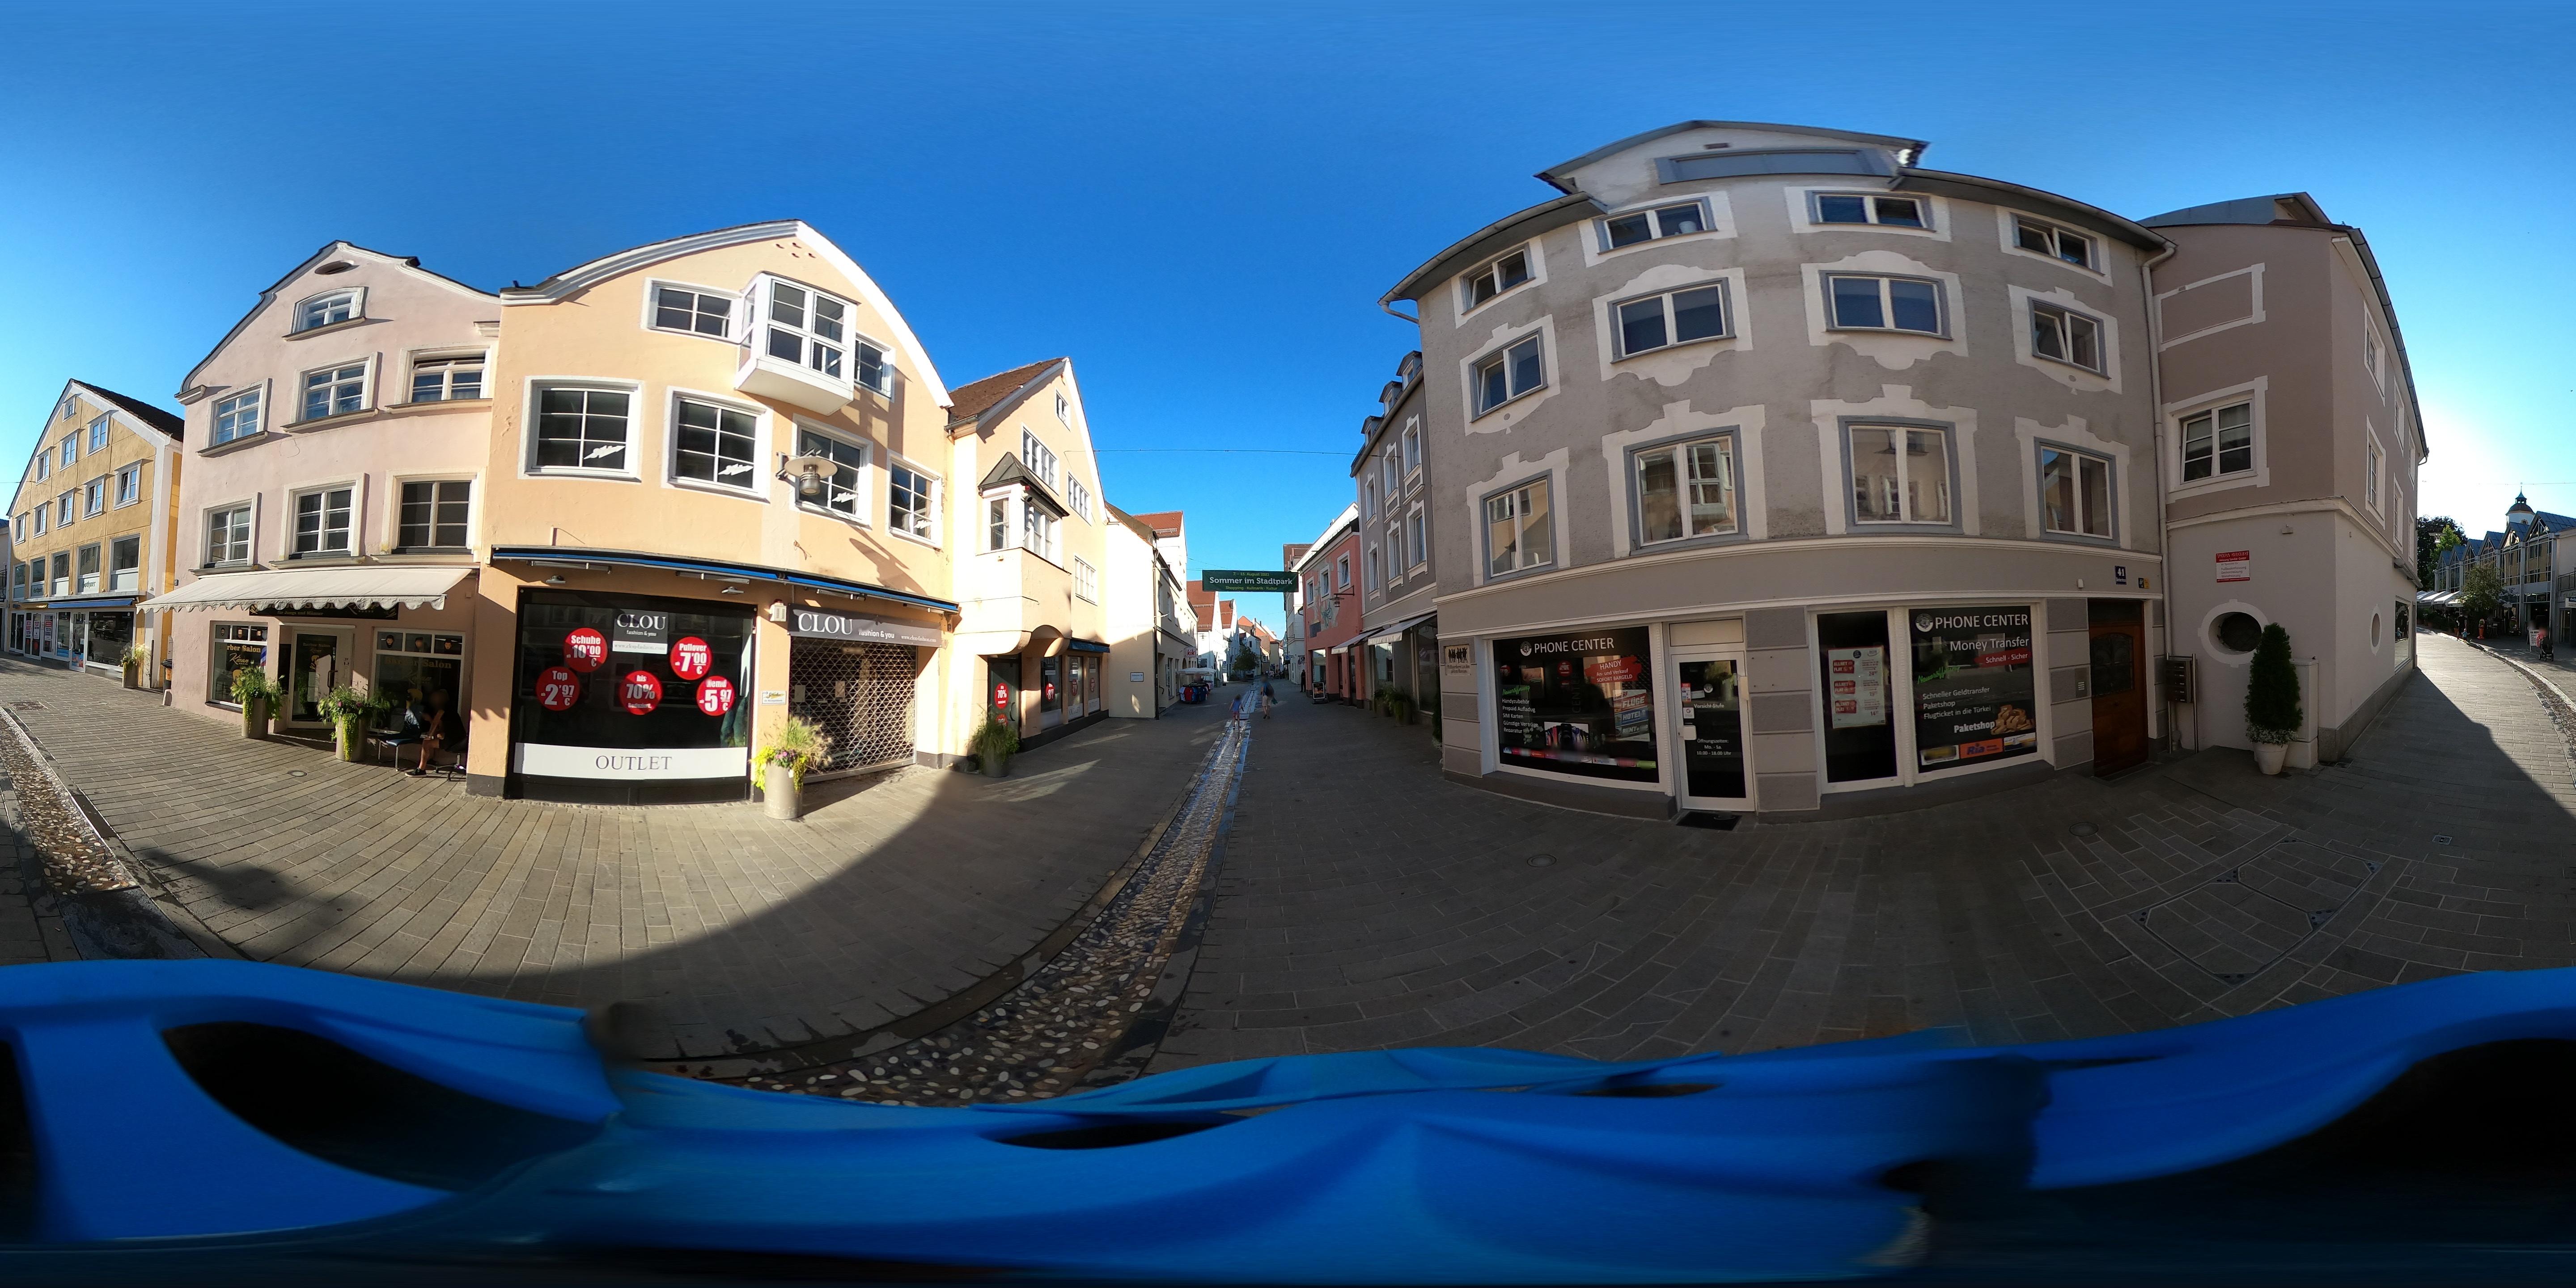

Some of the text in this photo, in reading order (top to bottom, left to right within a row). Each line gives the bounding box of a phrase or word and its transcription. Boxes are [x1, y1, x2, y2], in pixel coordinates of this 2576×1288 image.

[2118, 568, 2124, 576] 41
[1256, 577, 1292, 585] Stadtpark
[617, 613, 666, 630] CLOU
[798, 613, 852, 635] CLOU
[1935, 614, 2028, 629] PHONE CENTER
[571, 635, 601, 644] Schuhe
[1950, 636, 2029, 651] Money Transfer
[242, 645, 261, 653] Salon
[679, 643, 707, 652] Pullover
[1534, 641, 1569, 654] PHONE
[1572, 638, 1614, 651] CENTER
[421, 659, 452, 669] Salon
[591, 657, 597, 667] €
[1986, 655, 2006, 663] Schnell
[696, 665, 703, 674] €
[1599, 660, 1622, 670] HANDY
[552, 670, 568, 681] Top
[626, 684, 655, 699] 70%
[997, 690, 1007, 699] 70%
[1923, 687, 1990, 700] Schneller Geldtransfer
[564, 698, 570, 706] €
[722, 703, 729, 711] €
[1623, 696, 1645, 708] FLÜGE
[1924, 701, 1956, 709] Paketshop
[1924, 710, 1954, 720] Flugticket
[1954, 721, 1996, 733] Paketshop
[1967, 743, 1985, 755] Ria
[596, 755, 672, 770] OUTLET
